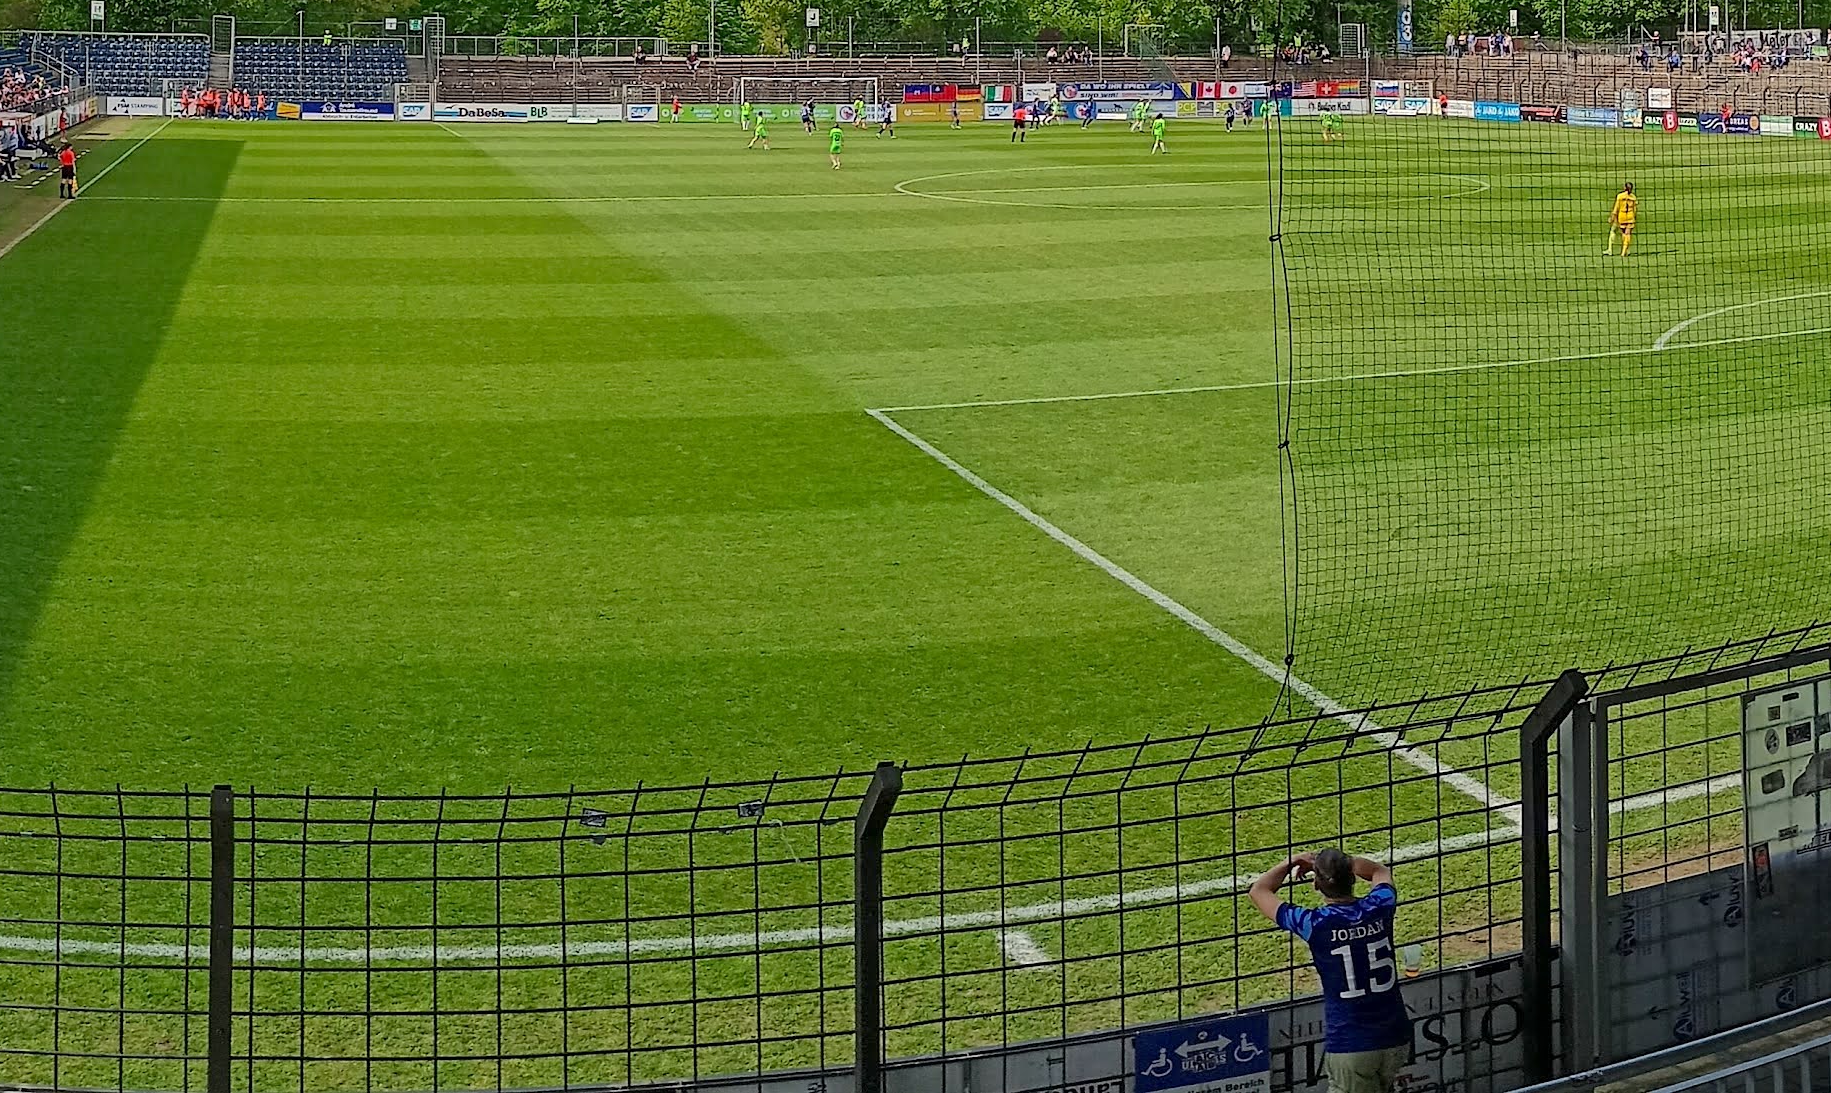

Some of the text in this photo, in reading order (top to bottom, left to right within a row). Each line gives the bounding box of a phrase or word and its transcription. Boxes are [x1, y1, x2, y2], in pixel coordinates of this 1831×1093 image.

[403, 106, 420, 116] SAP
[458, 107, 505, 118] DaBeSa
[1330, 918, 1384, 942] JORDAN
[1330, 936, 1397, 999] 15
